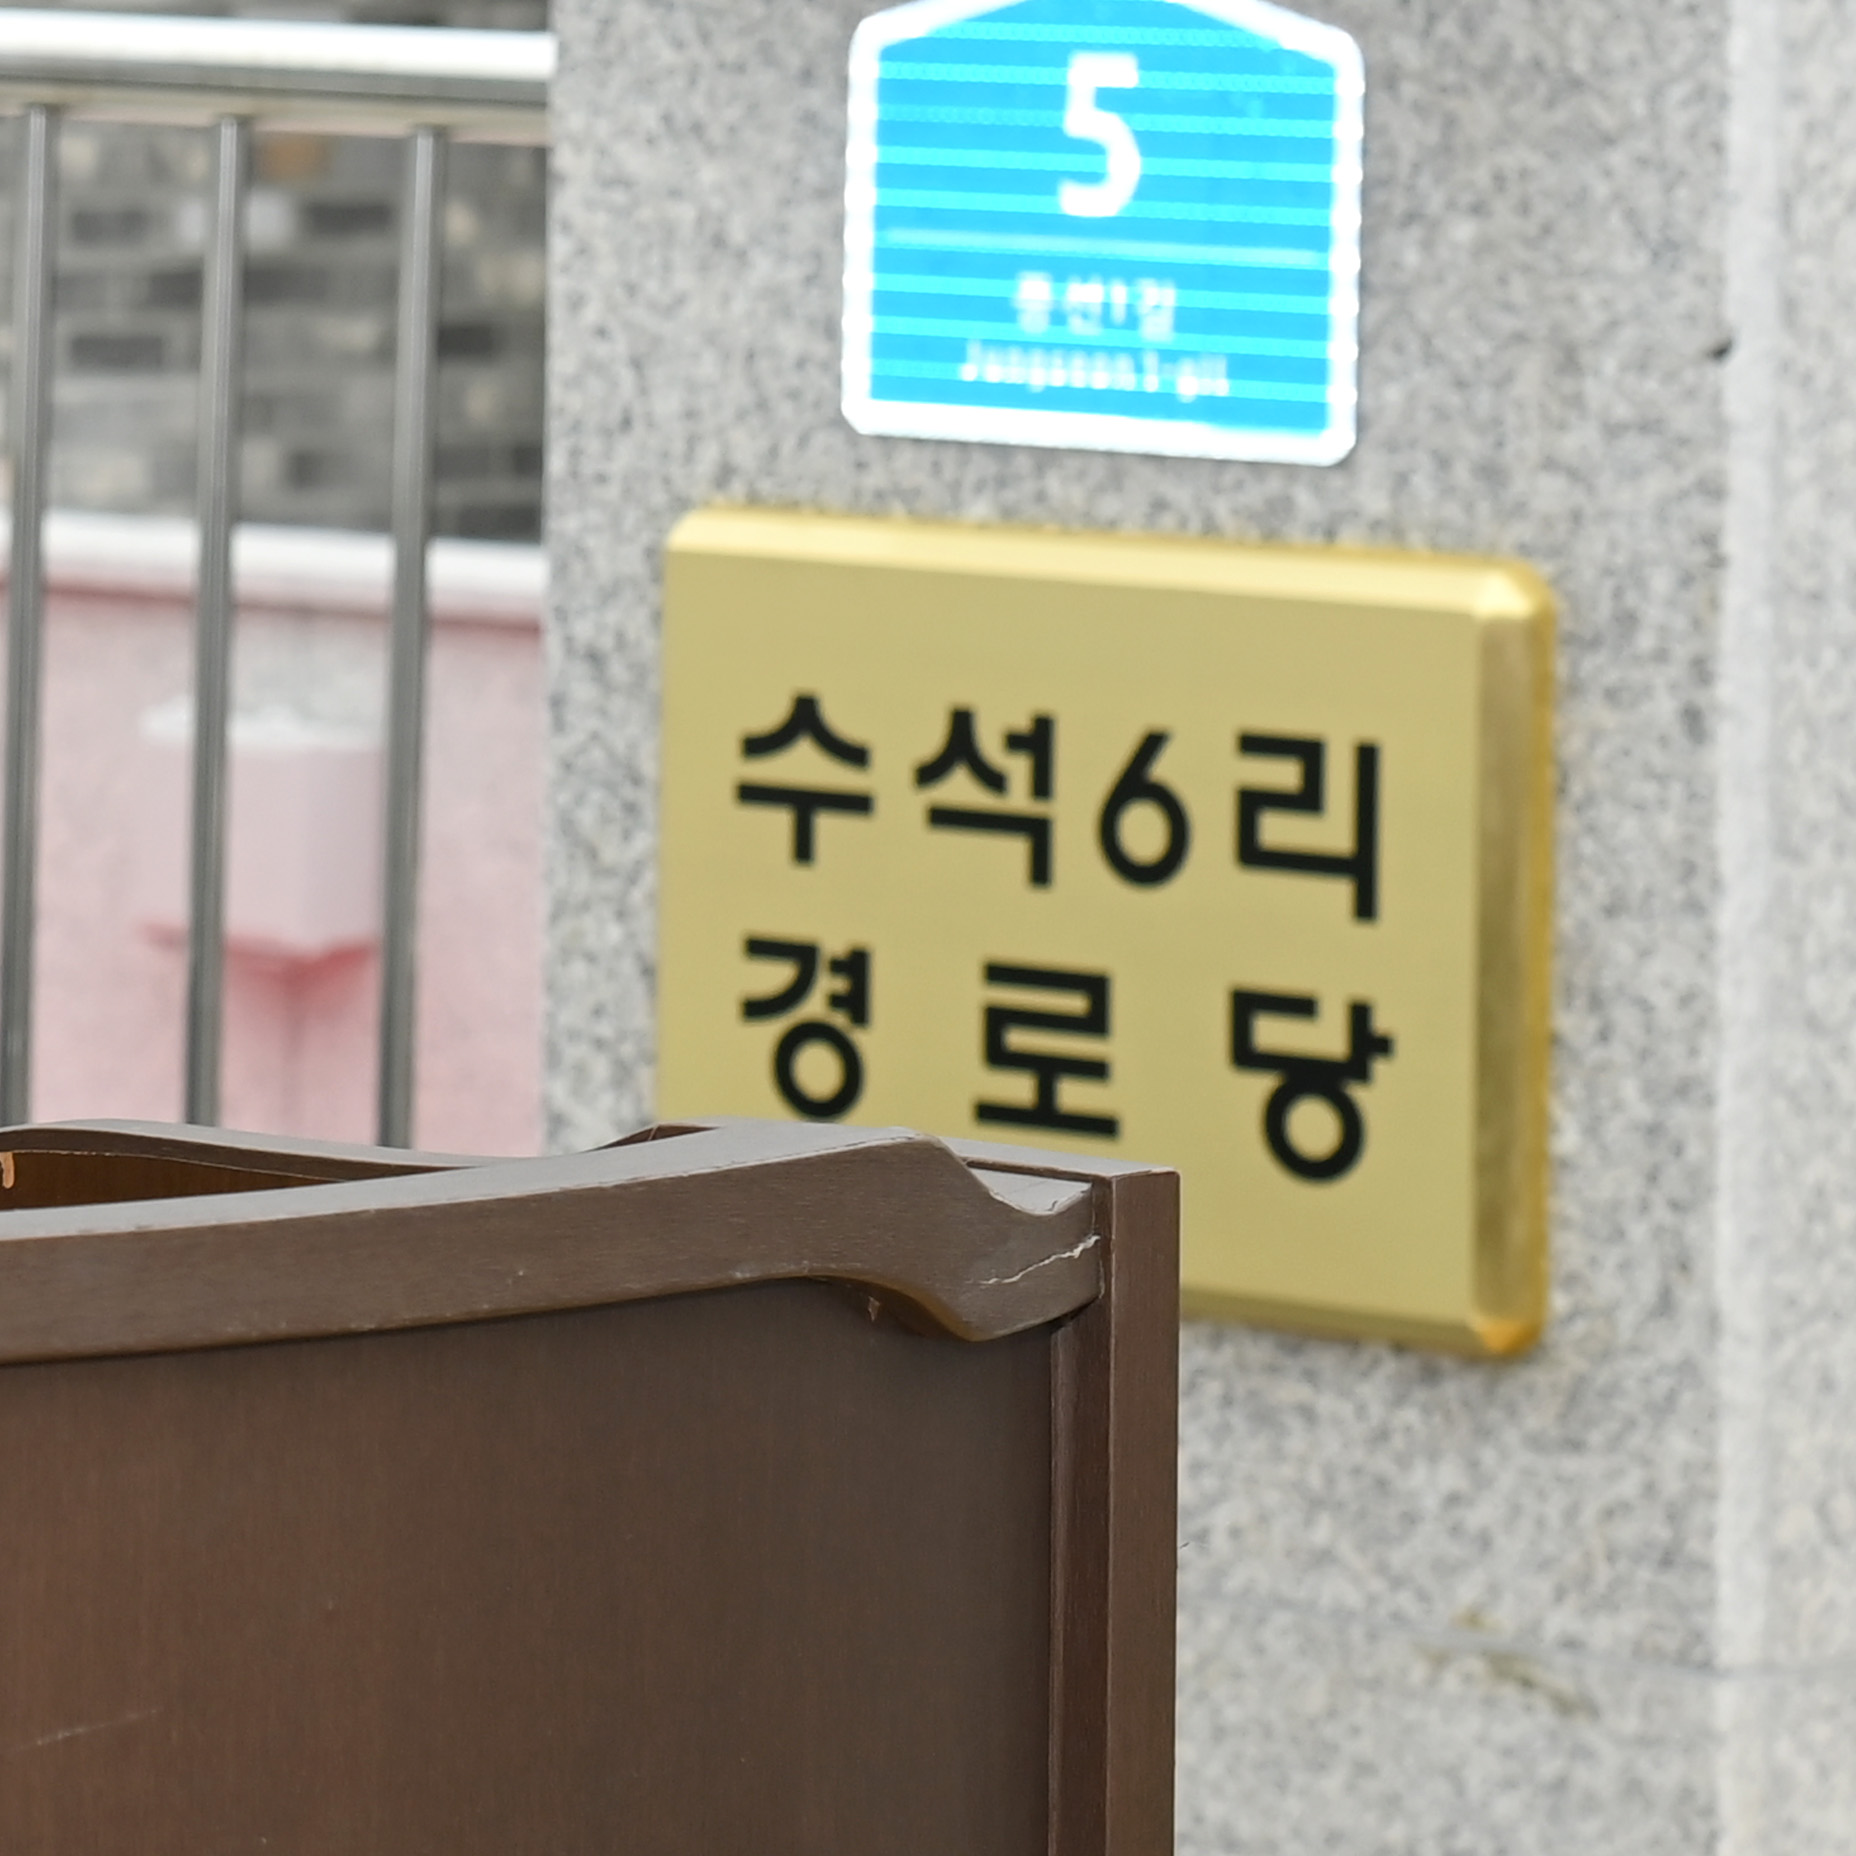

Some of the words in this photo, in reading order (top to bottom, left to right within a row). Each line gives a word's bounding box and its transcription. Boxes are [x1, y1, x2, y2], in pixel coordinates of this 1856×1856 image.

[1057, 51, 1142, 216] 5
[735, 692, 1380, 922] 수석6리
[740, 934, 1395, 1184] 경로당
